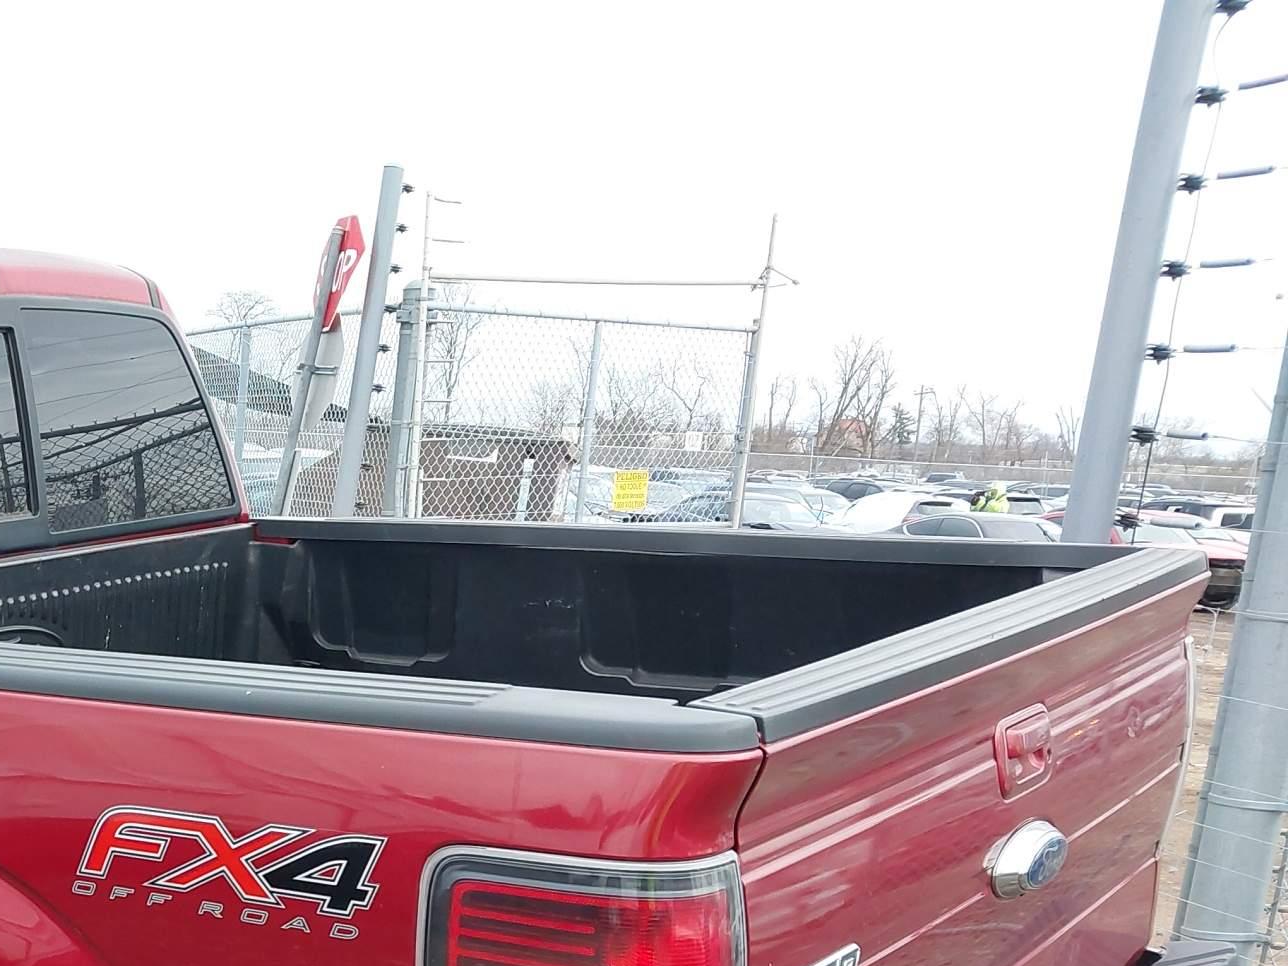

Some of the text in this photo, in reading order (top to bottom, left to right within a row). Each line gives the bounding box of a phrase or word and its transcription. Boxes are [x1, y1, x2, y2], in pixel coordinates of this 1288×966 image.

[75, 805, 388, 919] FX4
[72, 880, 360, 940] OFF ROAD
